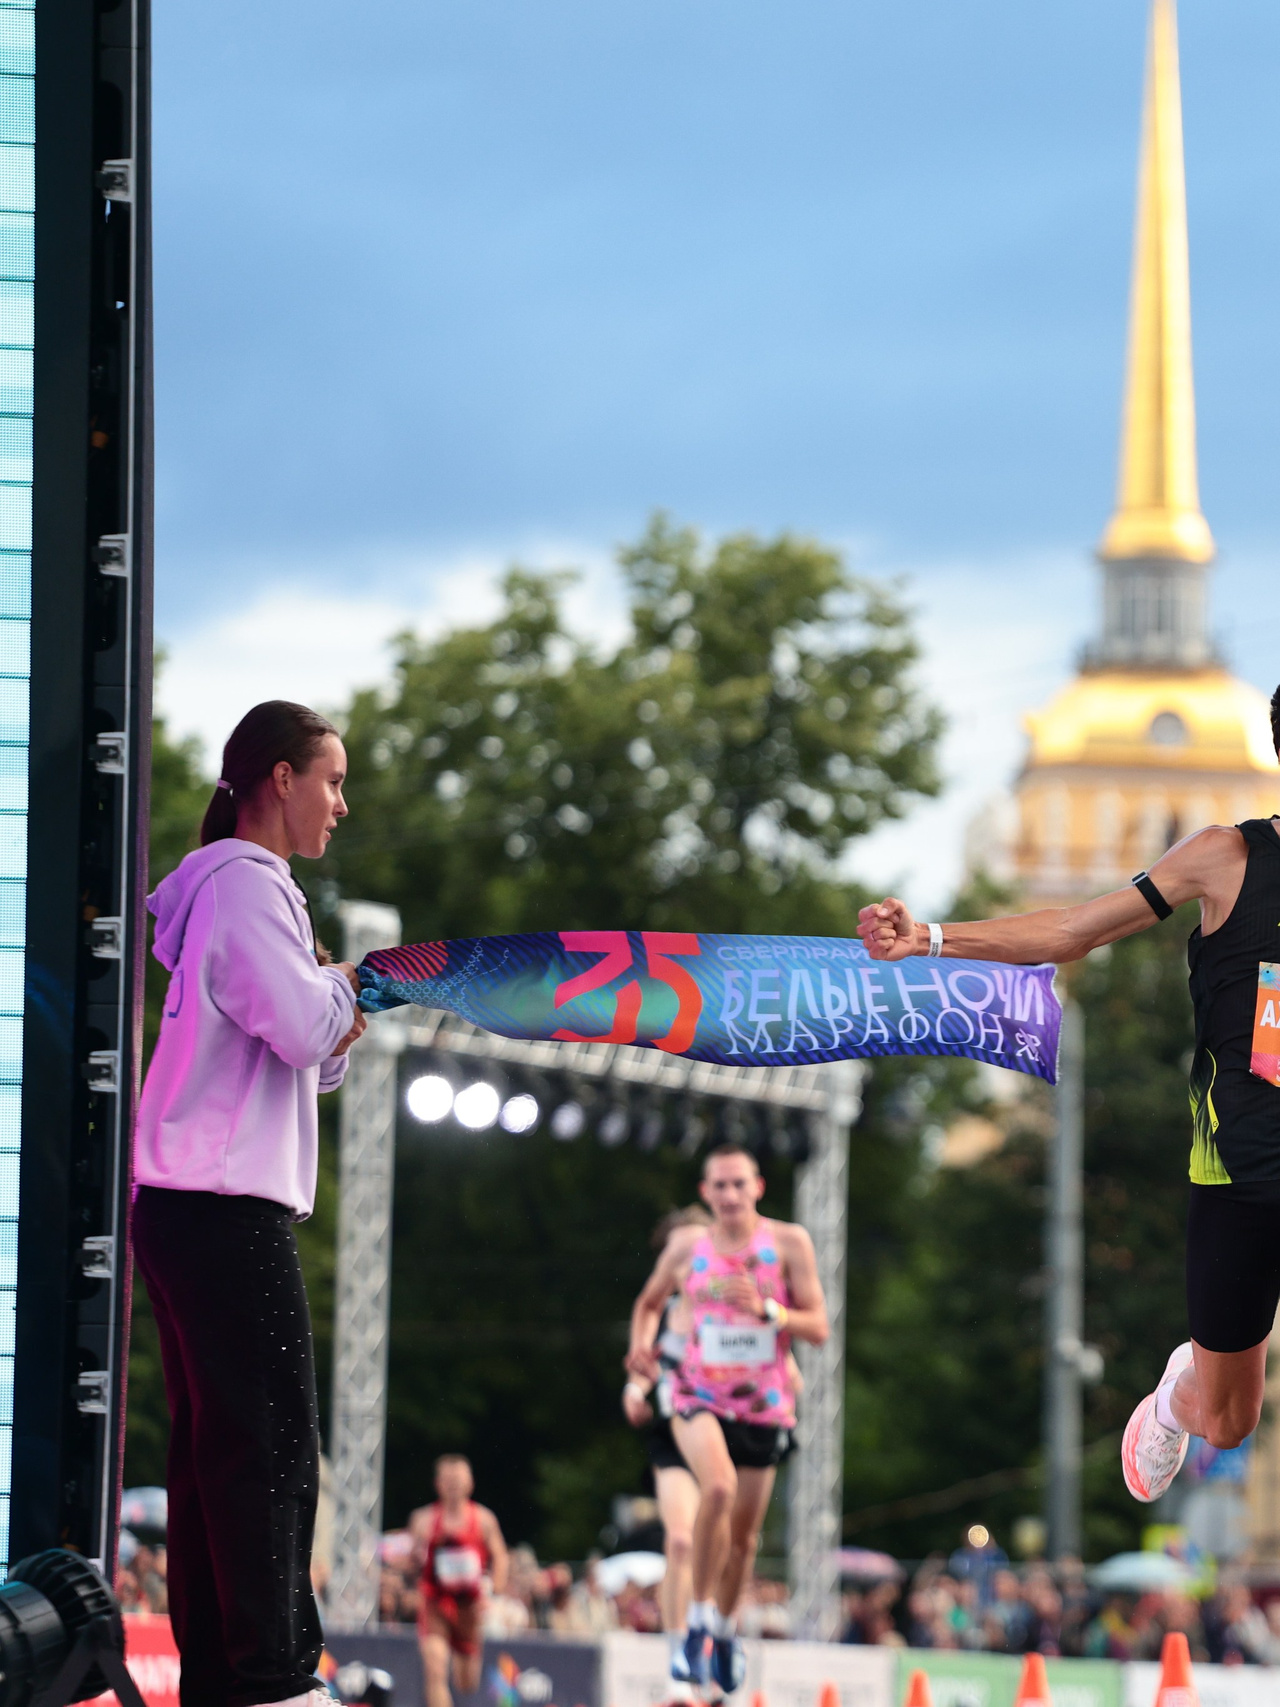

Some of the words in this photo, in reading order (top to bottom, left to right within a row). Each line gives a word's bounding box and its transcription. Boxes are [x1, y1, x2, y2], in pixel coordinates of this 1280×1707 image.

[716, 945, 871, 961] СБЕРПРАЙ
[551, 931, 703, 1054] 35
[719, 967, 889, 1022] БЕЛЫЕ
[894, 966, 1046, 1025] НОЧИ
[723, 1006, 1005, 1055] МАРАФОН
